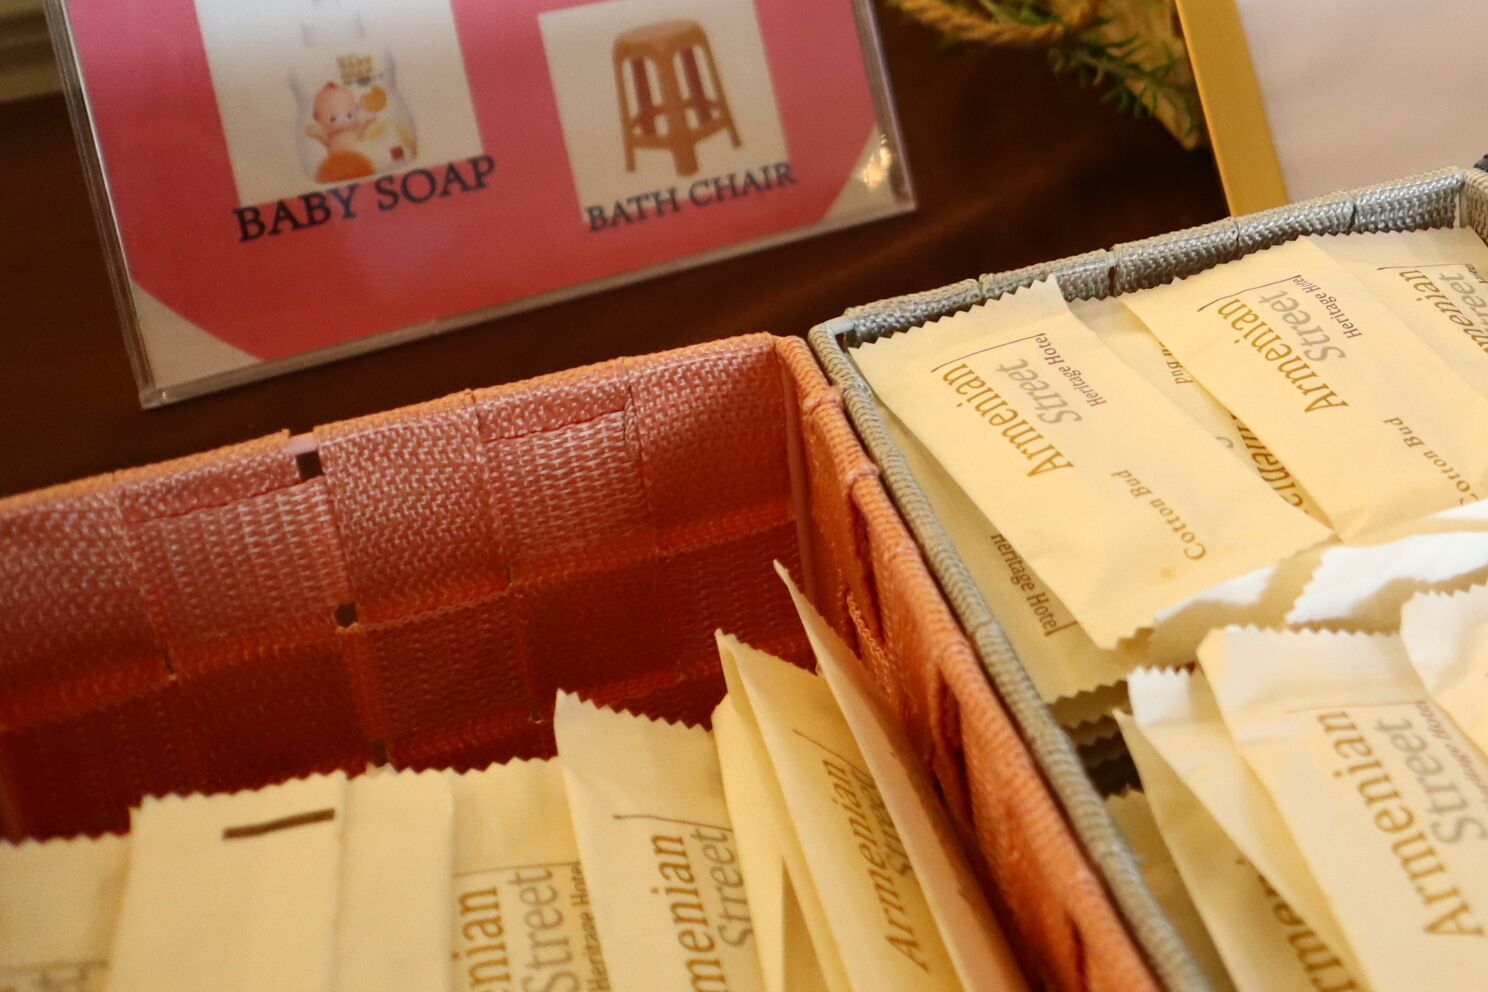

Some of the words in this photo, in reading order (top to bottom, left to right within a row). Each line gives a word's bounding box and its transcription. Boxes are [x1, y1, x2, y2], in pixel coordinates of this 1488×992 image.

[233, 183, 363, 243] BABY
[376, 155, 496, 213] SOAP
[585, 193, 682, 233] BATH
[688, 161, 795, 209] CHAIR
[1035, 334, 1064, 364] Hotel
[1258, 289, 1346, 362] Street
[1314, 291, 1362, 339] Heritage
[1057, 364, 1107, 407] Heritage
[1217, 298, 1348, 412] Armenian
[942, 363, 1074, 477] Armenian
[996, 359, 1082, 424] Street
[1382, 416, 1425, 449] Bud
[1109, 469, 1152, 499] Bud
[1149, 491, 1206, 561] Cotton
[1027, 591, 1059, 636] Hotel
[1318, 710, 1487, 937] Armenian
[691, 828, 753, 947] Street
[823, 760, 928, 974] Armenian
